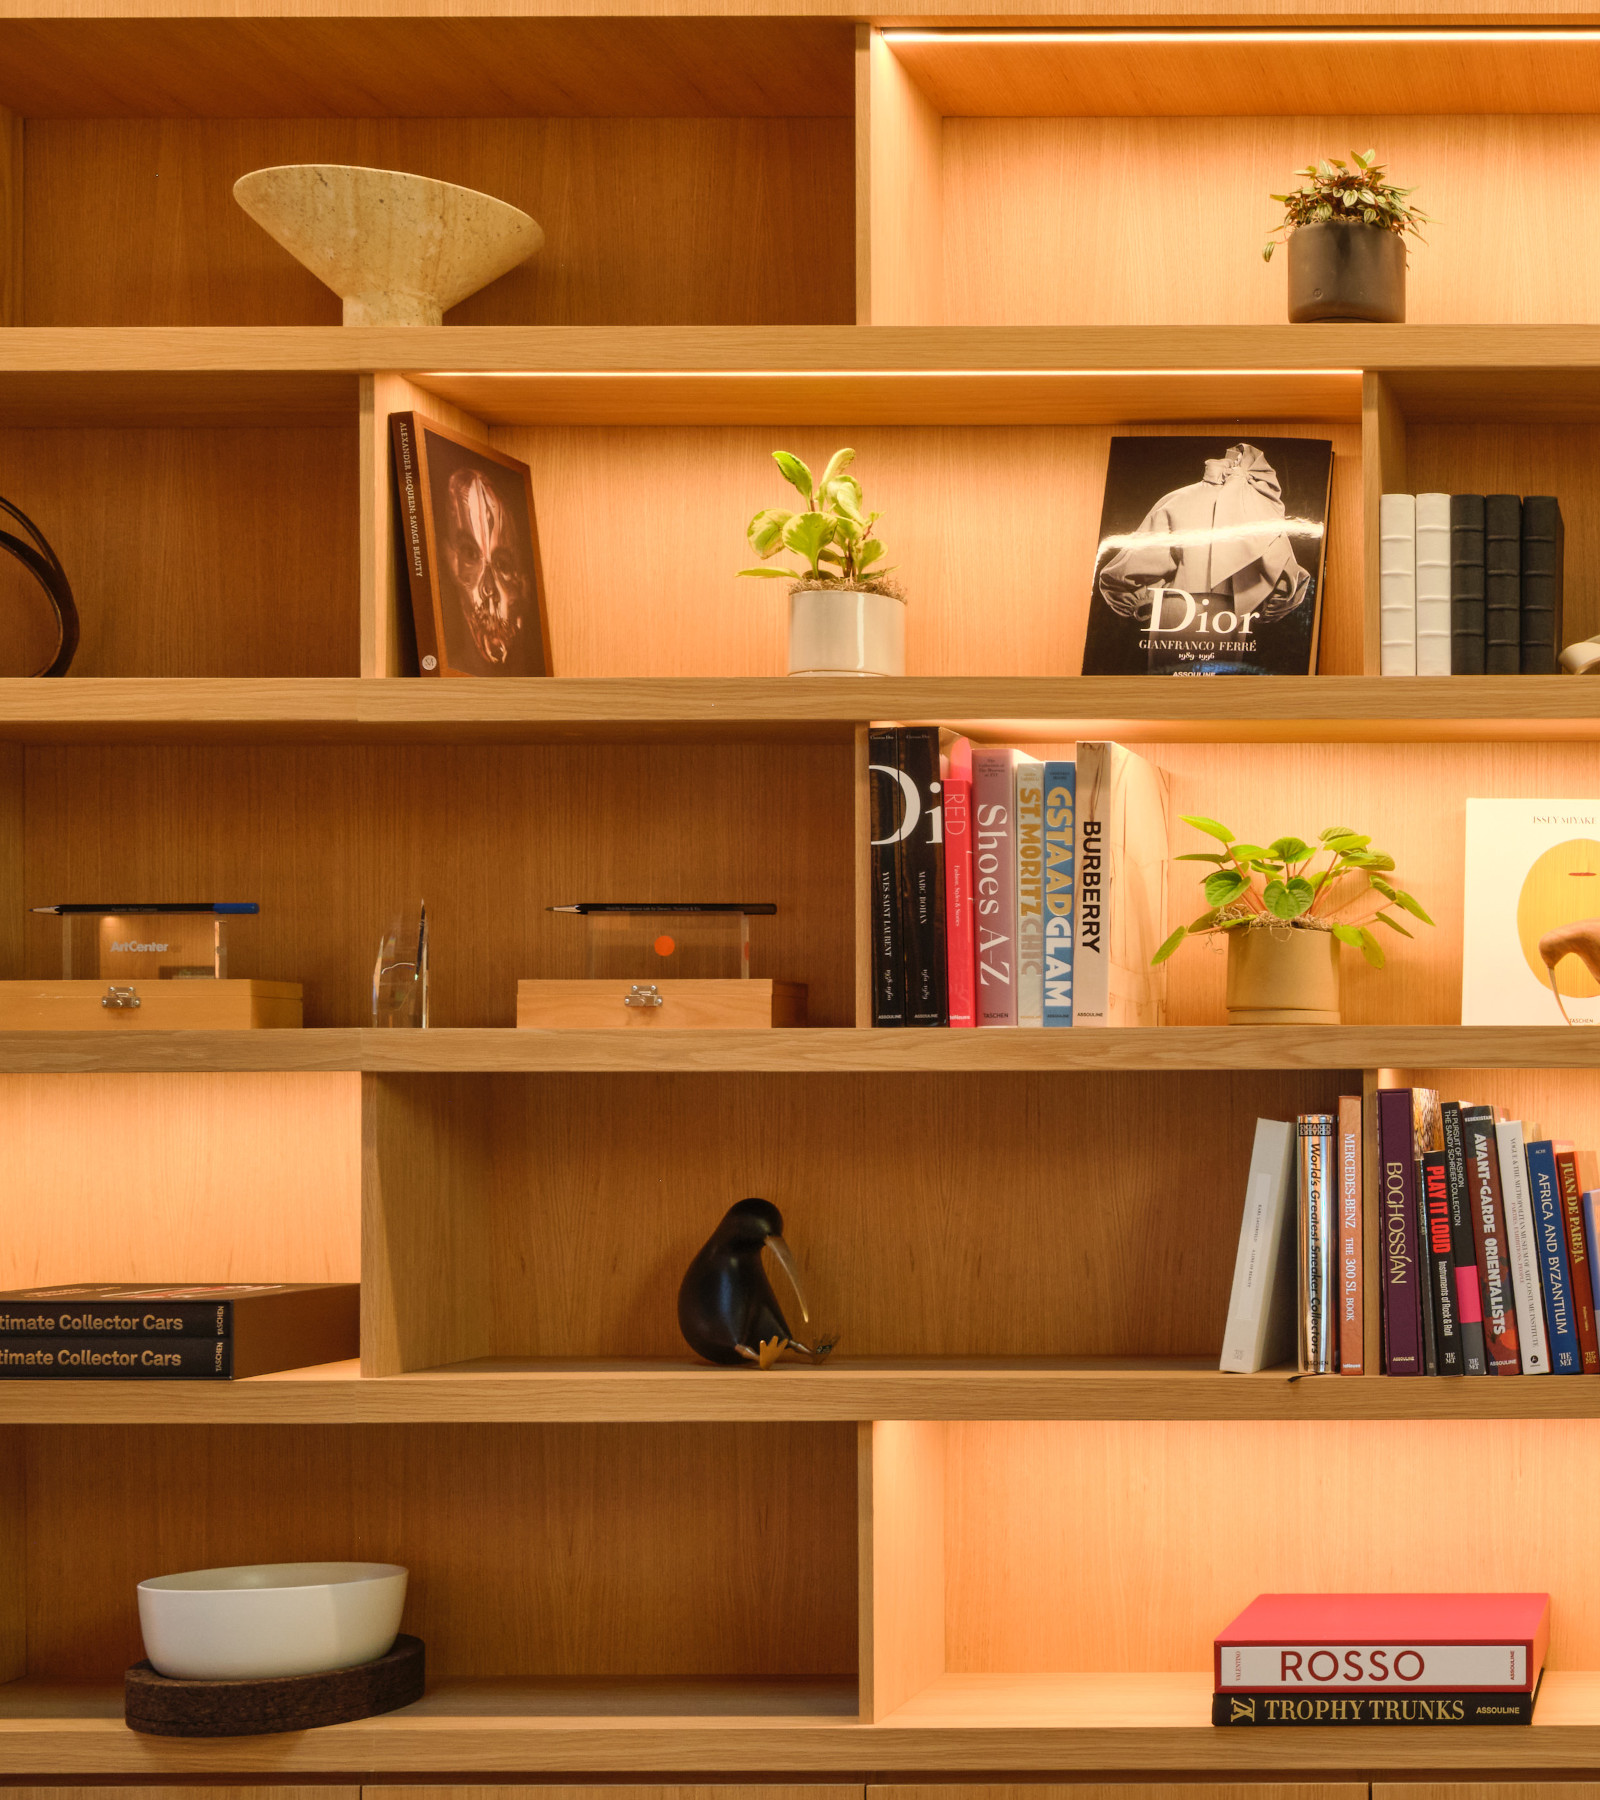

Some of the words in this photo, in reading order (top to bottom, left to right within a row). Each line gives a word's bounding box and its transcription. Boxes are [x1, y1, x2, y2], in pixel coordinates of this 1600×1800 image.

[399, 422, 411, 470] ALEXANDER
[410, 516, 419, 544] SAVAGE
[414, 547, 423, 577] BEAUTY
[1140, 587, 1261, 634] Dior
[1139, 639, 1215, 651] GIANFRANCO
[1219, 639, 1257, 651] FERRÉ
[944, 794, 965, 836] RED
[1533, 815, 1558, 825] ISSEY
[1561, 815, 1596, 825] MIYAKE
[977, 804, 1009, 915] Shoes
[1046, 787, 1073, 917] GSTAAD
[883, 872, 891, 892] YVES
[919, 871, 927, 894] MARC
[1020, 824, 1042, 917] MORITZ
[1081, 821, 1101, 955] BURBERRY
[883, 895, 892, 918] SAINT
[920, 897, 928, 924] BOHAN
[110, 940, 169, 952] ArtCenter
[884, 920, 893, 957] LAURENT
[1020, 918, 1042, 976] CHIC
[1045, 917, 1072, 1007] GLAM
[1445, 1125, 1454, 1148] SANDY
[1452, 1117, 1461, 1145] PURSUIT
[1310, 1142, 1321, 1186] World's
[1447, 1150, 1457, 1181] SCHREIER
[1454, 1147, 1462, 1156] OF
[1344, 1133, 1356, 1229] MERCEDES-BENZ
[1426, 1165, 1446, 1199] PLAY
[1455, 1158, 1465, 1188] FASHION
[1474, 1133, 1495, 1234] AVANT-GARDE
[1560, 1162, 1577, 1193] JUAN
[1429, 1201, 1448, 1215] IT
[1450, 1182, 1461, 1226] COLLECTION
[1538, 1172, 1554, 1220] AFRICA
[1567, 1196, 1579, 1214] DE
[1310, 1190, 1321, 1241] Greatest
[1386, 1162, 1413, 1284] BOGHOSSIAN
[1345, 1237, 1354, 1255] THE
[1430, 1217, 1451, 1253] LOUD
[1544, 1223, 1558, 1252] AND
[1570, 1216, 1584, 1264] PAREJA
[1310, 1244, 1322, 1293] Sneaker
[1345, 1258, 1356, 1278] 300
[1345, 1281, 1356, 1295] SL
[1484, 1238, 1506, 1335] ORIENTALISTS
[1548, 1256, 1568, 1334] BYZANTIUM
[59, 1314, 139, 1331] Collector
[142, 1314, 183, 1331] Cars
[216, 1305, 224, 1335] TASCHEN
[1345, 1297, 1354, 1321] BOOK
[1310, 1297, 1322, 1354] Collectors
[57, 1349, 138, 1366] Collector
[140, 1349, 182, 1366] Cars
[215, 1341, 224, 1372] TASCHEN
[1280, 1650, 1425, 1682] ROSSO
[1264, 1699, 1365, 1721] TROPHY
[1368, 1699, 1464, 1721] TRUNKS
